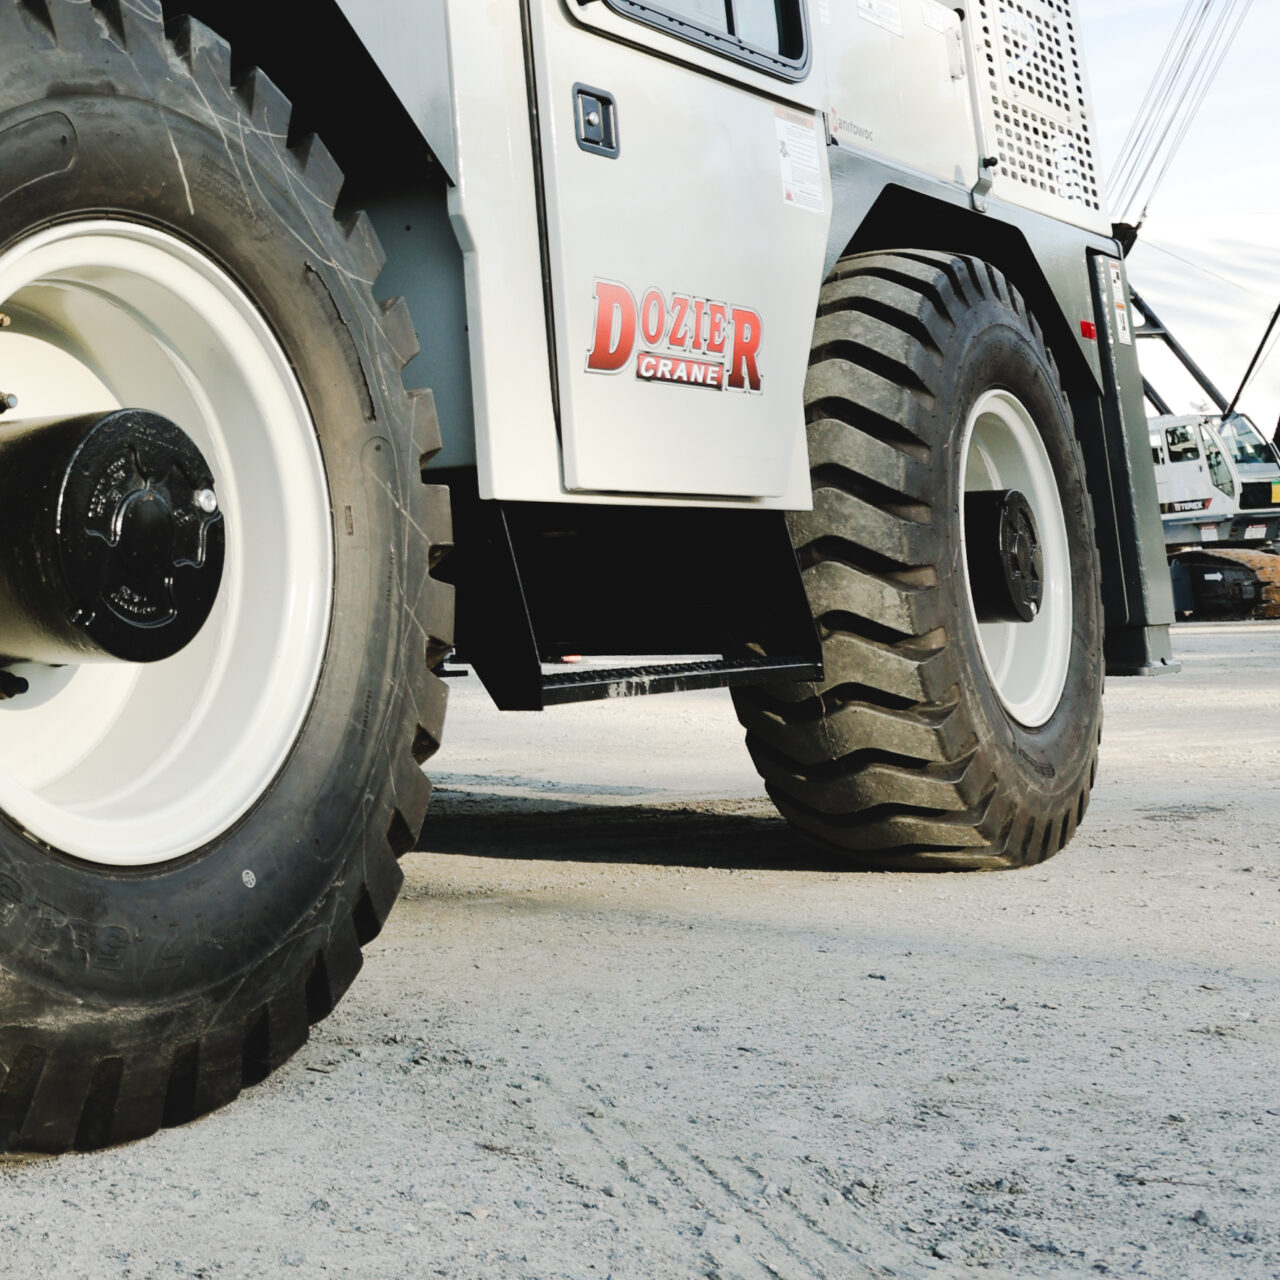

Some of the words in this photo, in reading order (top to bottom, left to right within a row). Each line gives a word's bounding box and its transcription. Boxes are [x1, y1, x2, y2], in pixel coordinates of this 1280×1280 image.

[586, 278, 763, 394] DOZIER
[639, 357, 721, 385] CRANE
[1180, 500, 1203, 511] TEREX
